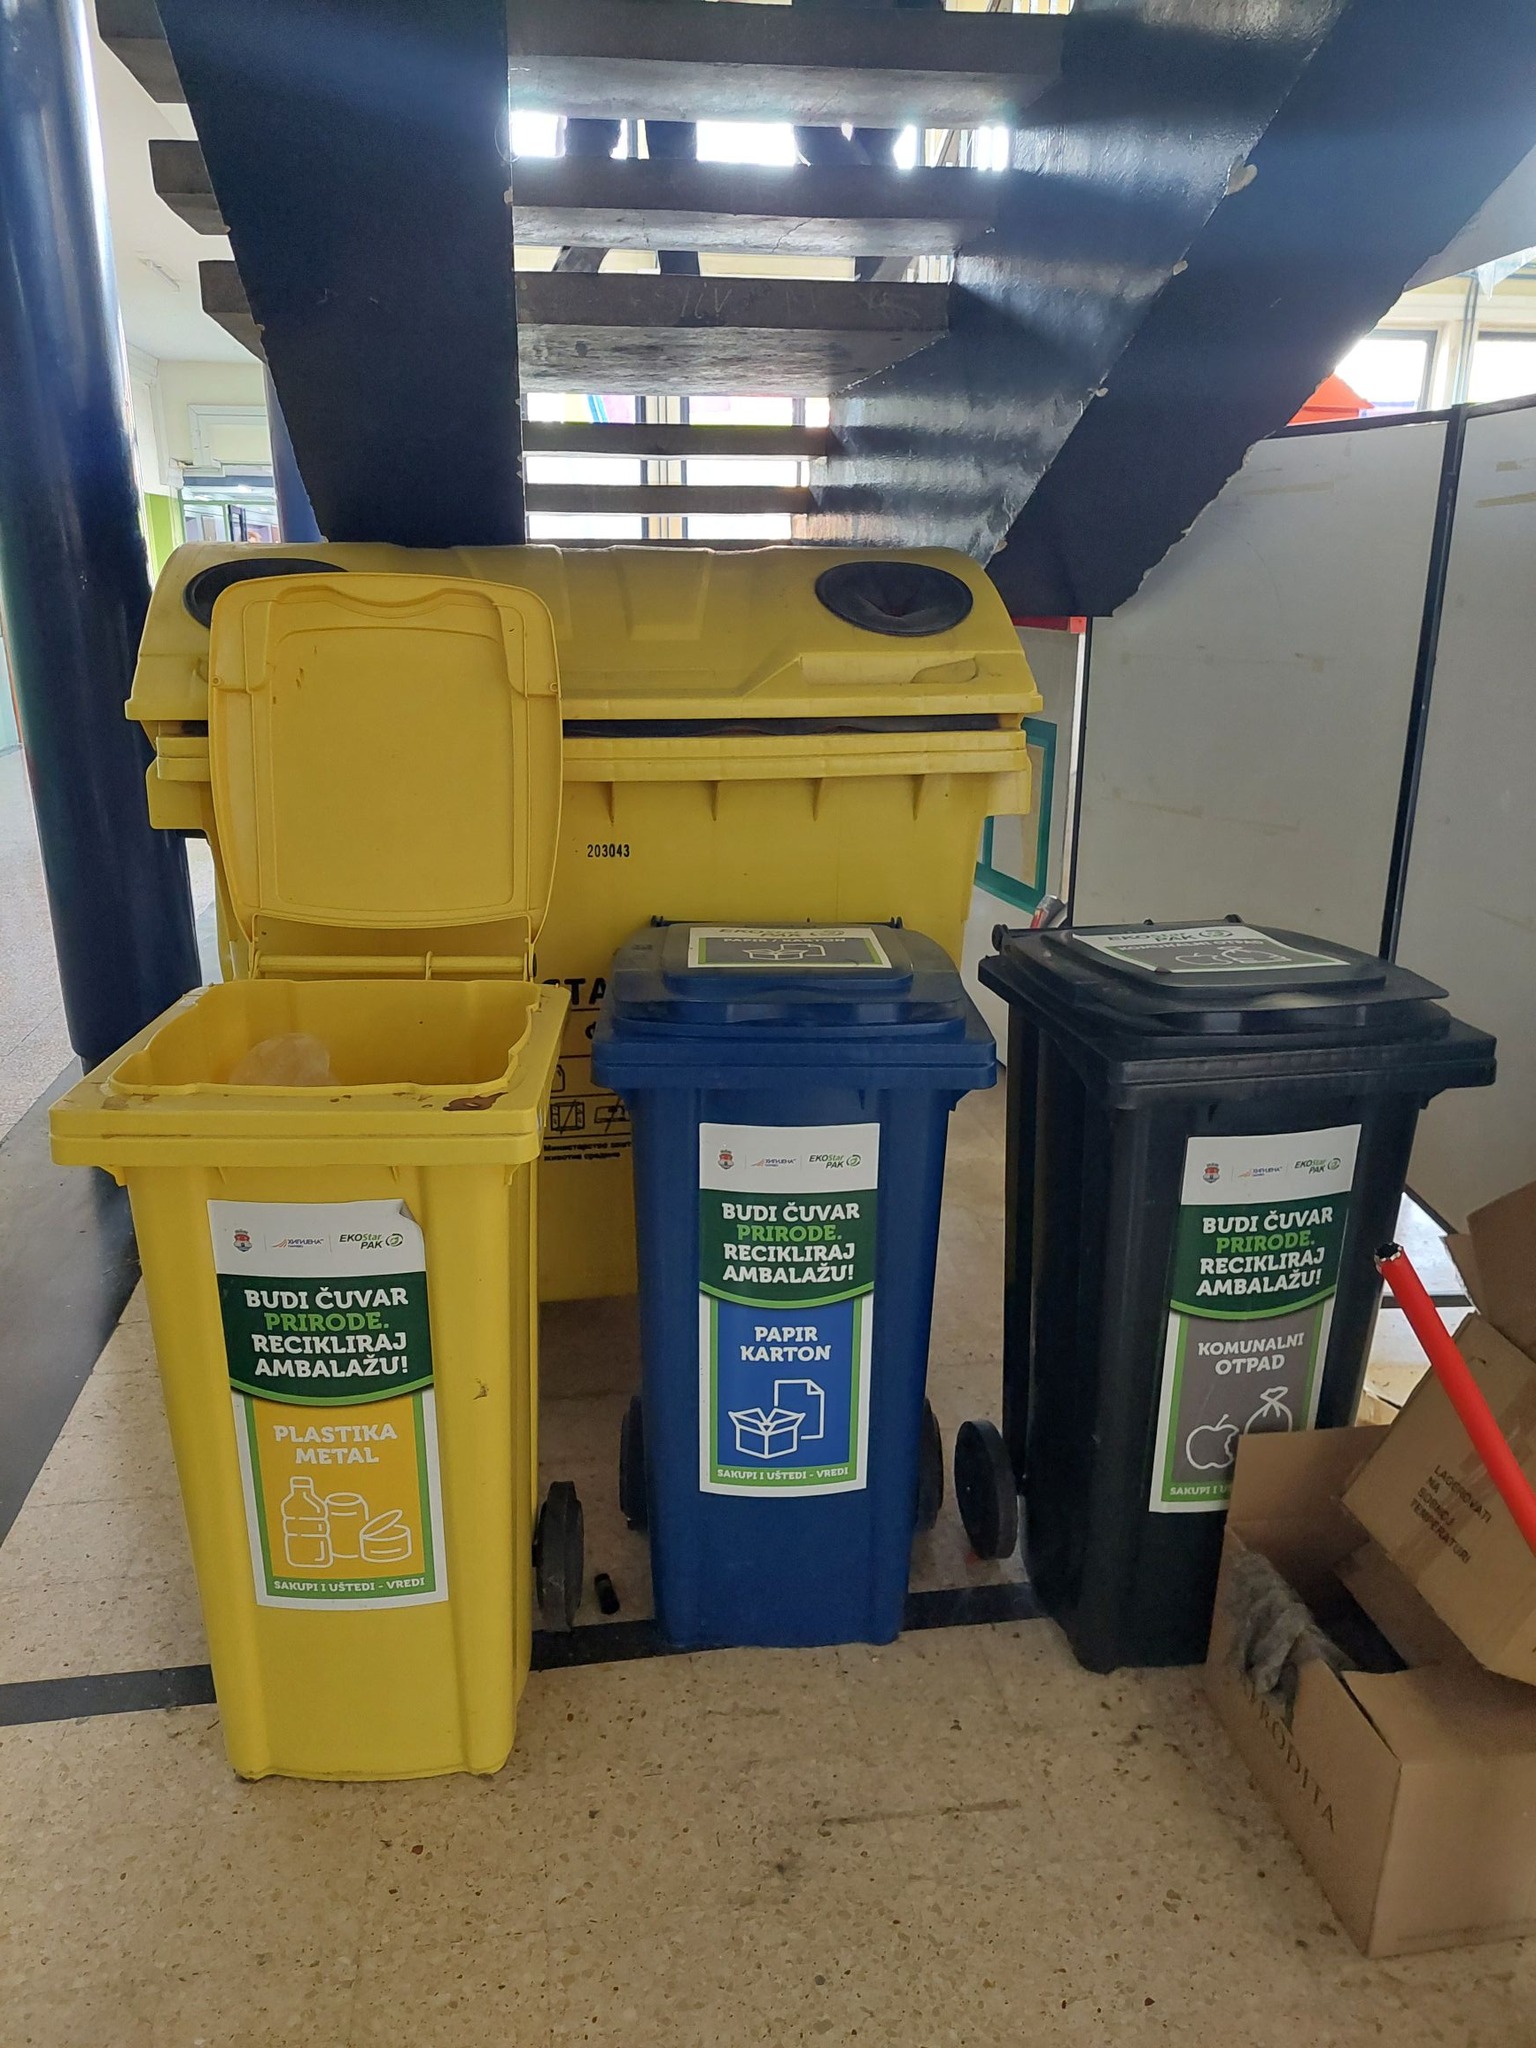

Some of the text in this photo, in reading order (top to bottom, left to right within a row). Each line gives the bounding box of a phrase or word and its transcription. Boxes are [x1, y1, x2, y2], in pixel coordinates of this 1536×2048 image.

[586, 843, 630, 858] 203043
[826, 1161, 844, 1169] PAK
[1308, 1165, 1326, 1174] PAK
[722, 1202, 860, 1222] BUDI ČUVAR
[1202, 1206, 1333, 1234] BUDI ČUVAR
[736, 1224, 842, 1242] PRIRODE.
[1216, 1229, 1315, 1254] PRIRODE.
[360, 1240, 383, 1250] PAK
[723, 1242, 856, 1263] RECIKLIRAJ
[1200, 1247, 1326, 1275] RECIKLIRAJ
[722, 1263, 854, 1284] AMBALAŽU!
[1196, 1267, 1322, 1297] AMBALAŽU!
[244, 1287, 409, 1310] BUDI ČUVAR
[264, 1311, 389, 1332] PRIRODE.
[251, 1332, 408, 1355] RECIKLIRAJ
[754, 1326, 819, 1343] PAPIR
[1198, 1332, 1305, 1356] KOMUNALNI
[740, 1344, 832, 1362] KARTON
[254, 1354, 409, 1378] AMBALAŽU!
[1215, 1354, 1286, 1376] OTPAD
[273, 1423, 398, 1443] PLASTIKA
[295, 1447, 379, 1465] METAL
[717, 1468, 757, 1480] SAKUPI
[759, 1471, 764, 1480] I
[767, 1470, 807, 1481] UŠTEDI
[816, 1467, 849, 1479] VREDI
[1170, 1485, 1211, 1496] SAKUPI
[273, 1580, 319, 1592] SAKUPI
[321, 1583, 327, 1592] I
[329, 1580, 376, 1593] UŠTEDI
[386, 1577, 425, 1590] VREDI
